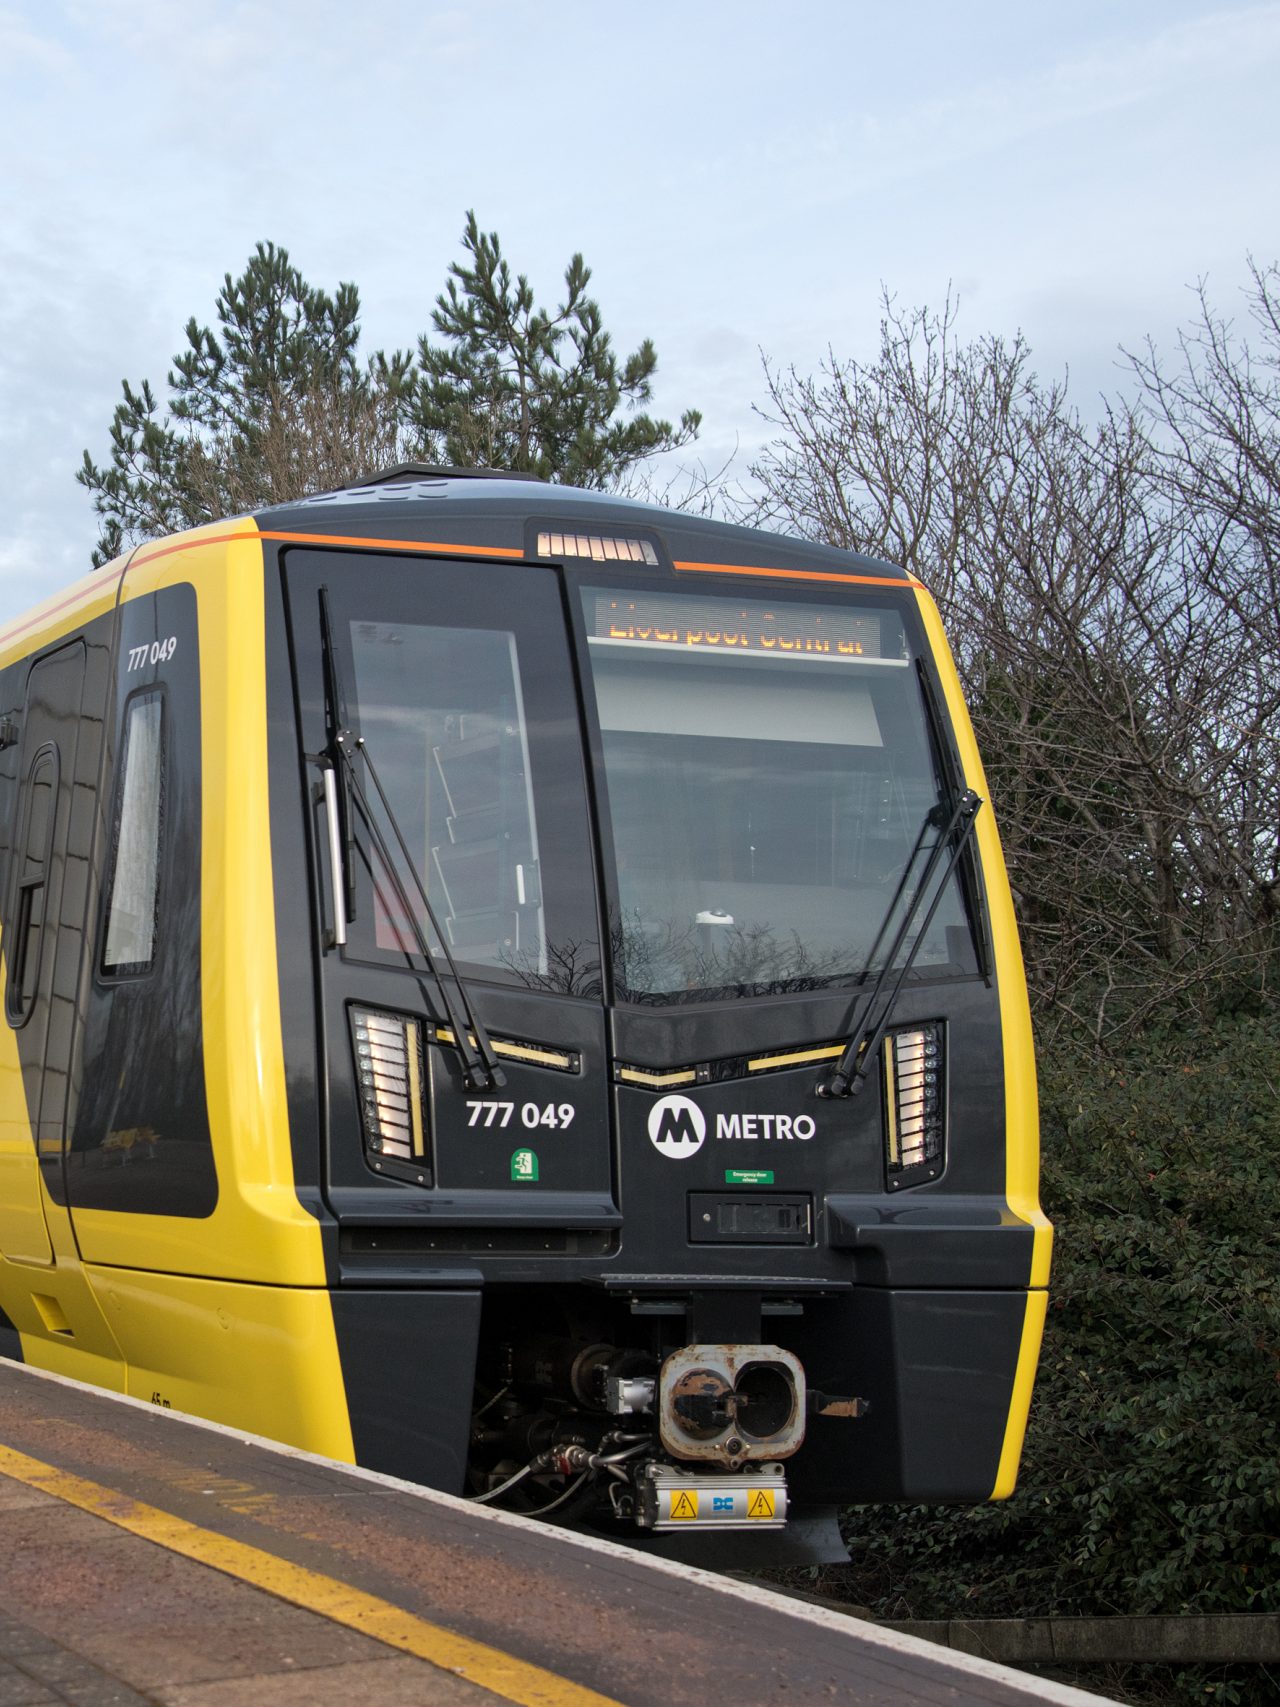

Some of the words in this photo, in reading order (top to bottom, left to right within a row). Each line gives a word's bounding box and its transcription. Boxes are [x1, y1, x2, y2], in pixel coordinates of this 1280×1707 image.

[127, 644, 150, 672] 777
[150, 636, 177, 665] 049
[465, 1100, 515, 1128] 777
[521, 1102, 575, 1129] 049
[656, 1108, 699, 1142] M
[716, 1113, 816, 1140] METRO
